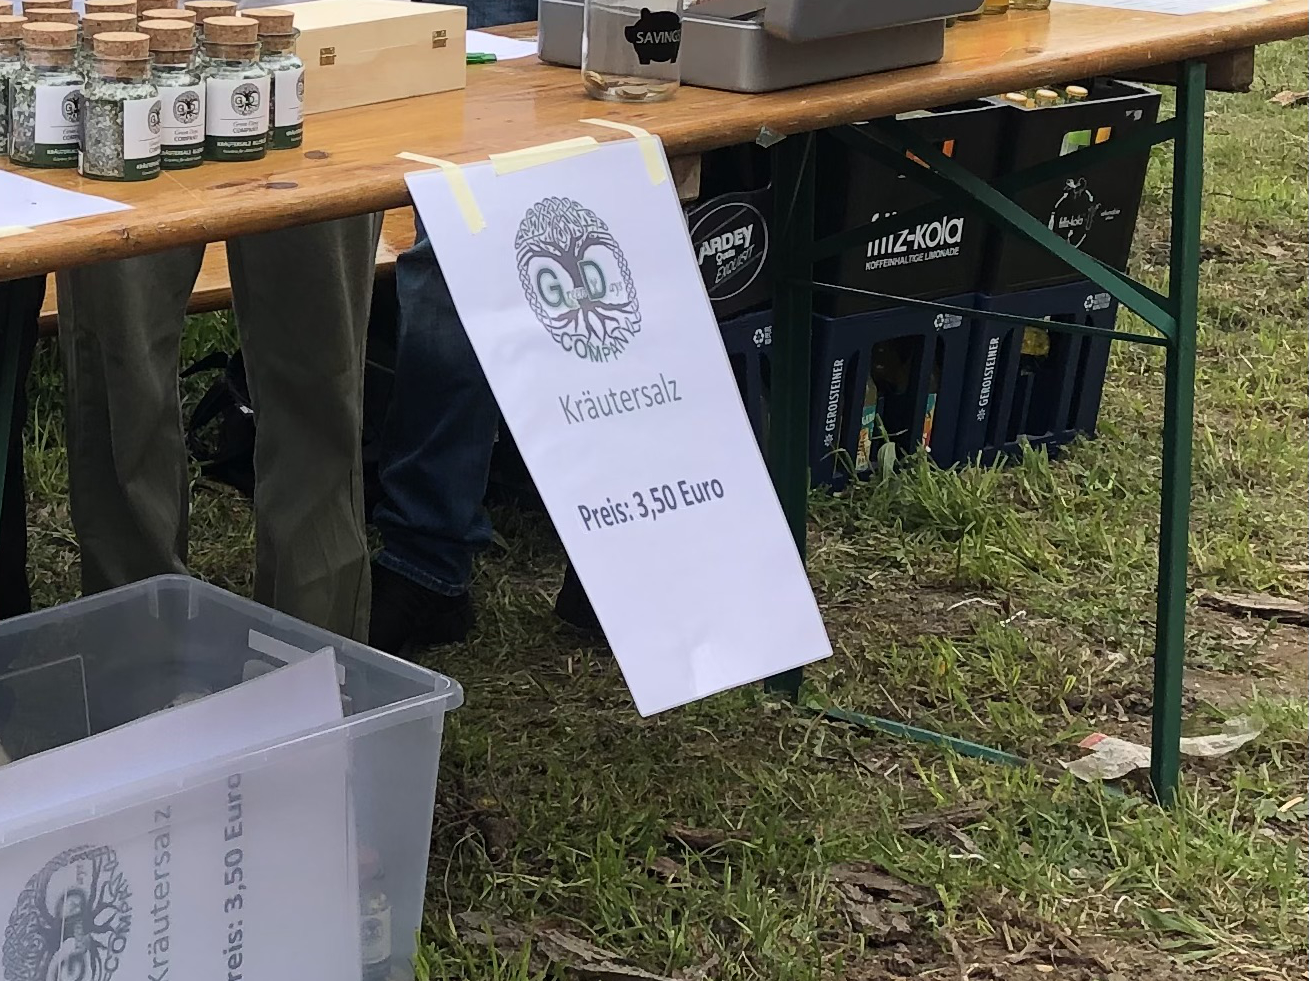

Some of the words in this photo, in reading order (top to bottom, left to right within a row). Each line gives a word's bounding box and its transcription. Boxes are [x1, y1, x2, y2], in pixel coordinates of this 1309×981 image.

[635, 28, 681, 44] SAVING
[697, 223, 754, 266] ARDEY
[865, 252, 924, 271] KOFFEINHALTIGE
[924, 246, 960, 261] LIMONADE
[558, 373, 682, 425] Kräutersalz
[825, 358, 844, 432] GEROLSTEINER
[978, 336, 1000, 407] GEROLSTEINER
[577, 497, 634, 531] Preis:
[632, 484, 677, 521] 3,50
[677, 478, 725, 506] Euro
[224, 772, 243, 841] Euro
[224, 848, 247, 913] 3,50
[223, 919, 244, 981] reis:
